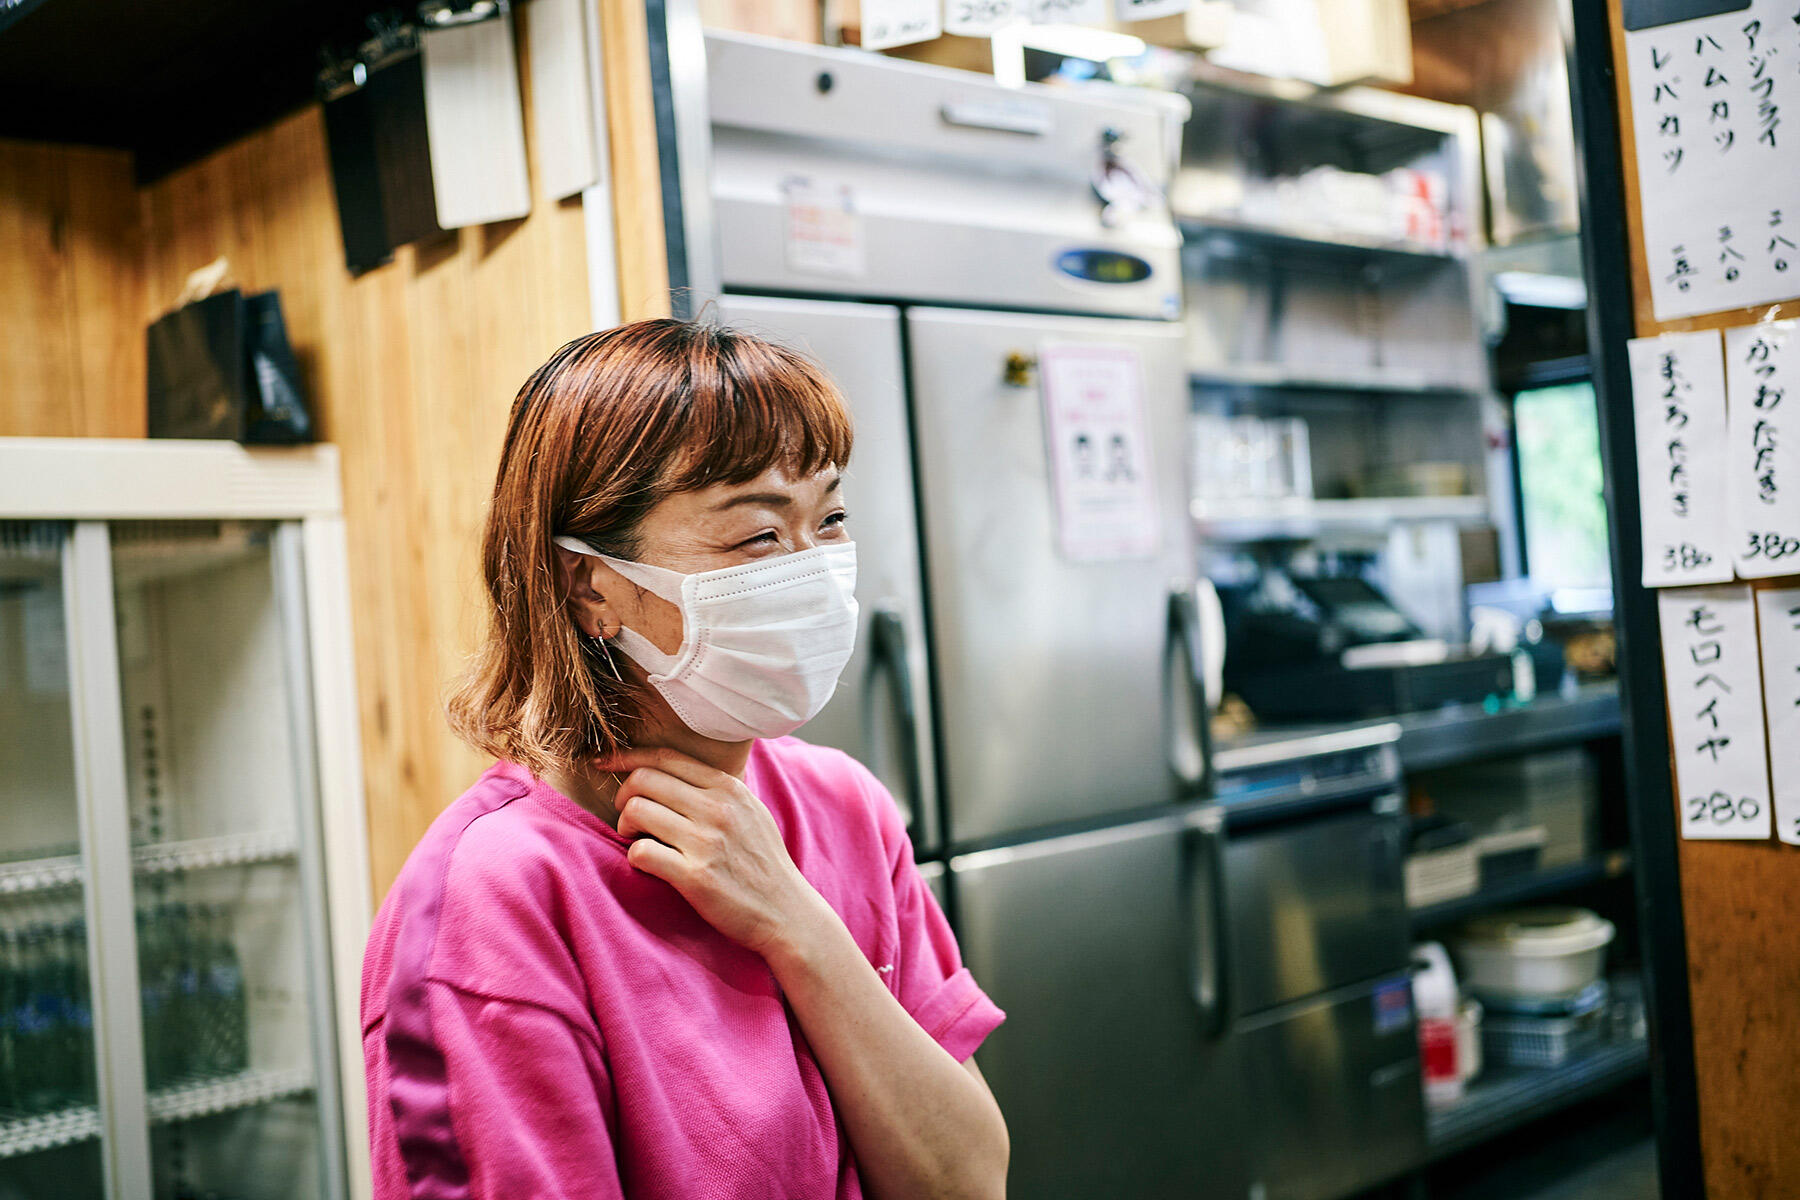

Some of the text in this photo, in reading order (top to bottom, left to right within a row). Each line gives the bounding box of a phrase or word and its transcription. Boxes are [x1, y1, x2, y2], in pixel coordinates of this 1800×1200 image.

[1651, 47, 1683, 174] レバカツ
[1696, 34, 1734, 153] ハムカツ
[1742, 20, 1780, 148] アジフライ
[1661, 351, 1692, 518] まぐろたたき
[1746, 338, 1785, 504] かつおたたき
[1663, 542, 1712, 571] 380
[1742, 531, 1800, 560] 380
[1685, 606, 1731, 763] モロヘイヤ
[1688, 791, 1760, 826] 280
